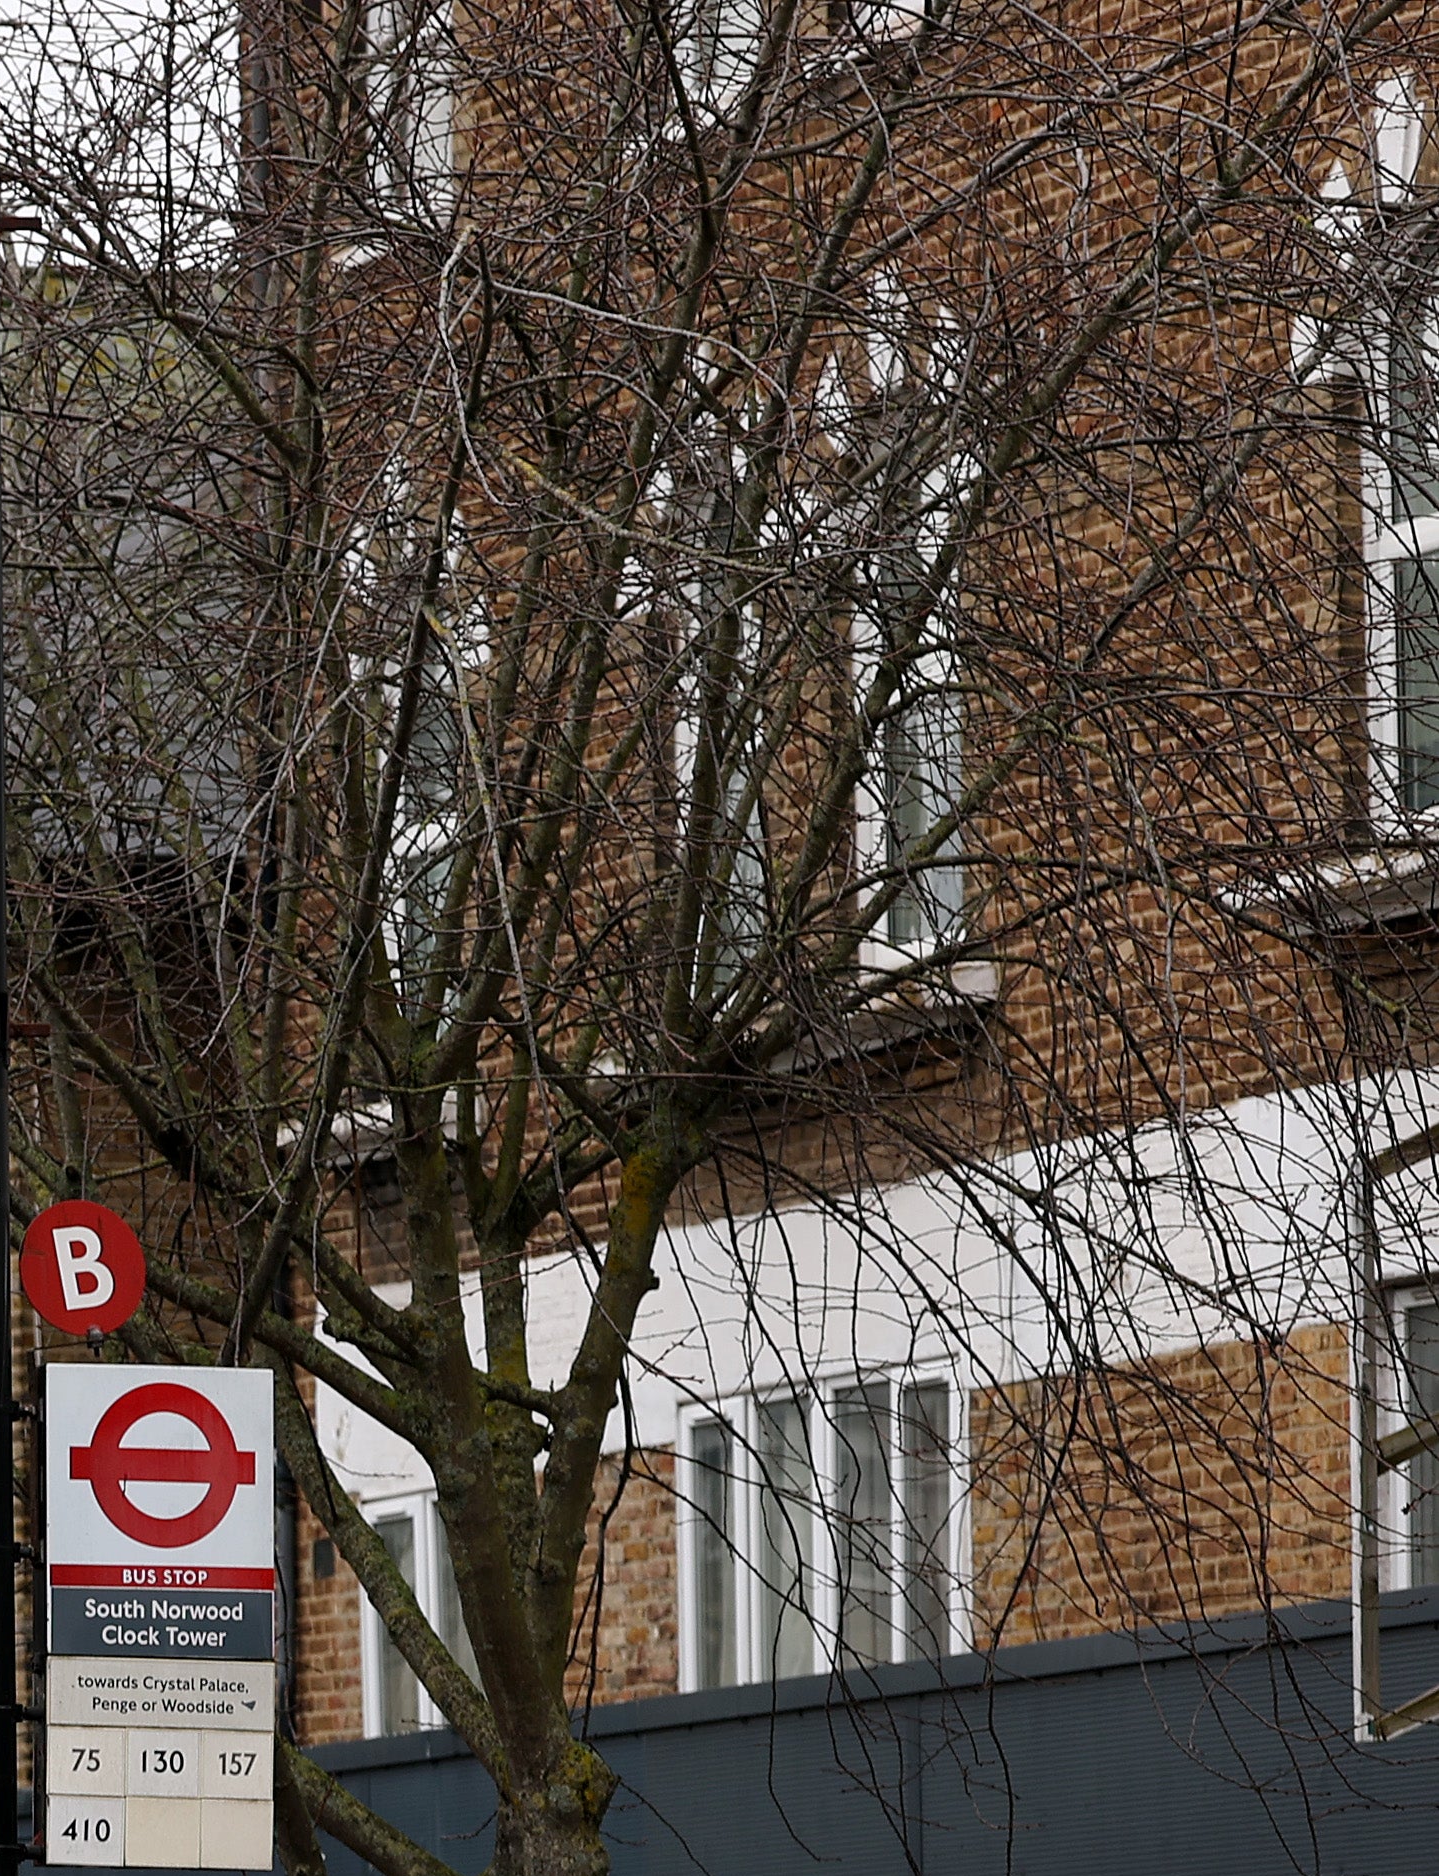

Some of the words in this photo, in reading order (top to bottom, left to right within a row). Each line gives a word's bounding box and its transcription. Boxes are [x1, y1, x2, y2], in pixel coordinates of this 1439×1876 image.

[52, 1226, 114, 1311] B
[122, 1567, 158, 1586] BUS
[163, 1568, 208, 1586] STOP
[85, 1598, 146, 1621] South
[152, 1600, 244, 1622] Norwood
[102, 1625, 159, 1646] Clock
[164, 1627, 226, 1647] Tower
[77, 1674, 139, 1691] towards
[143, 1675, 196, 1696] Crystal
[92, 1698, 137, 1716] Penge
[141, 1702, 157, 1713] or
[161, 1698, 235, 1715] Woodside
[71, 1748, 101, 1772] 75
[140, 1748, 184, 1774] 130
[218, 1752, 256, 1776] 157
[62, 1818, 111, 1843] 410
